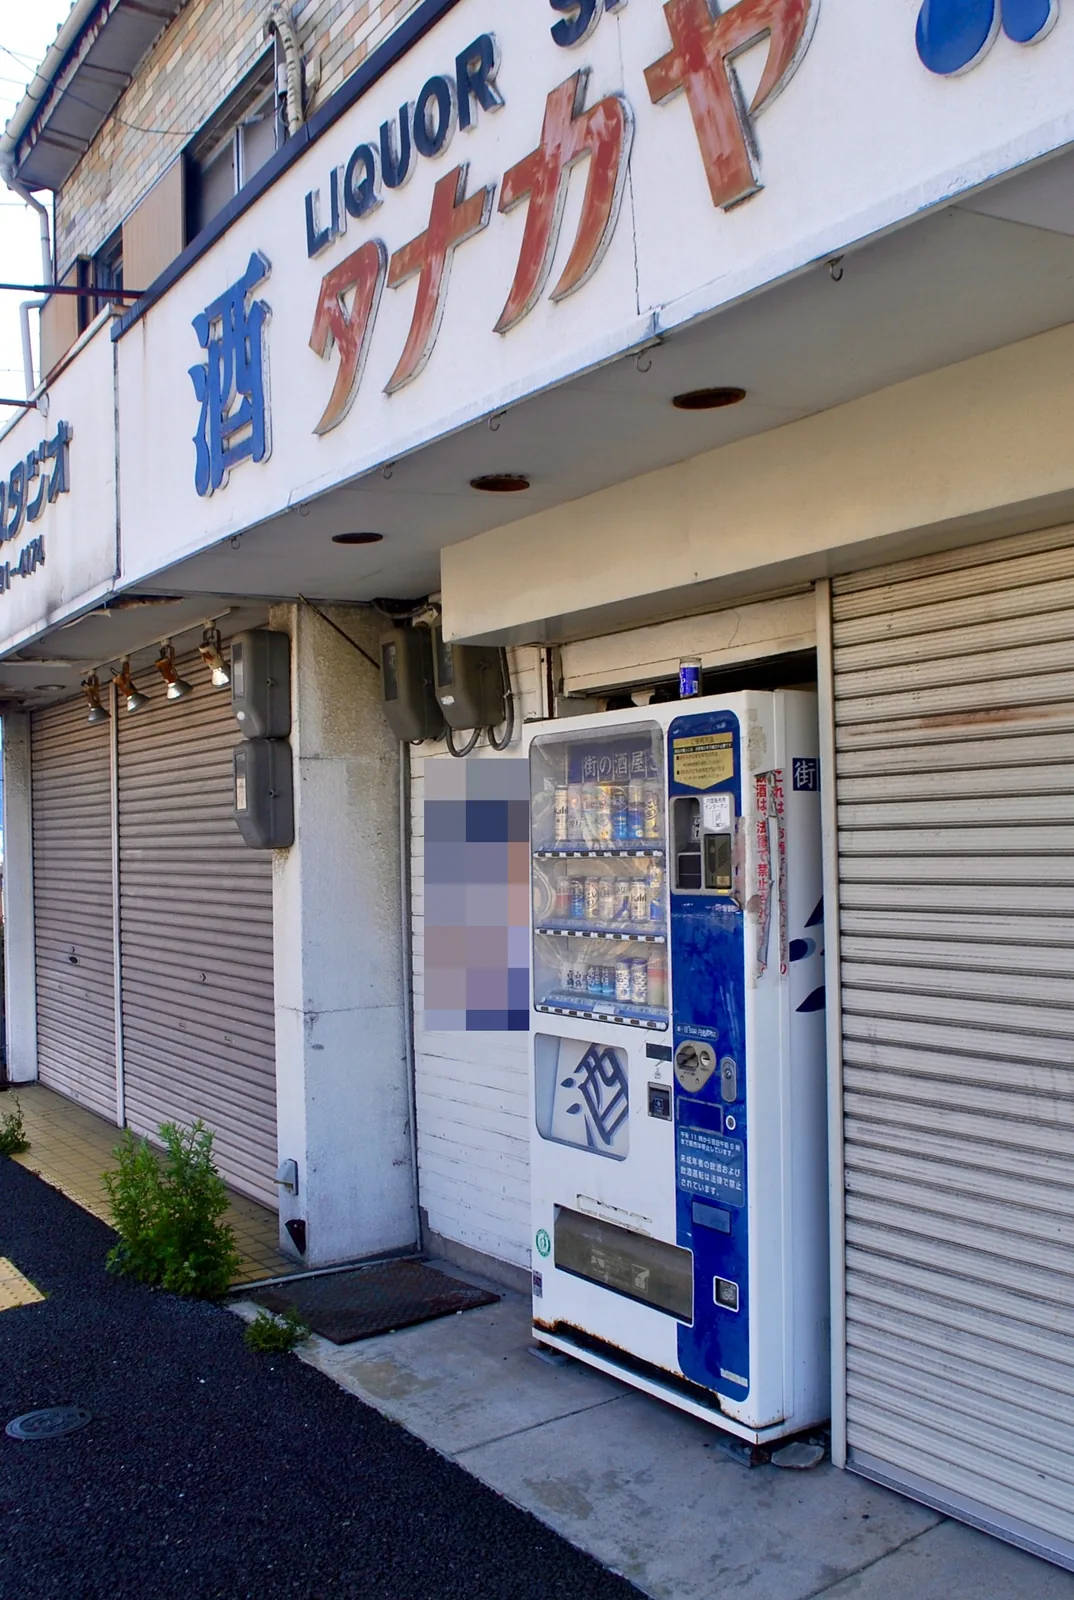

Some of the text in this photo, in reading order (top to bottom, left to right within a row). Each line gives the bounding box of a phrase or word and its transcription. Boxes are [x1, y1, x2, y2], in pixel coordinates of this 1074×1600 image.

[305, 33, 505, 258] LIQUOR
[309, 0, 822, 435] タナカヤ
[188, 249, 272, 497] 酒
[794, 760, 816, 789] 街
[560, 1042, 629, 1146] 酒
